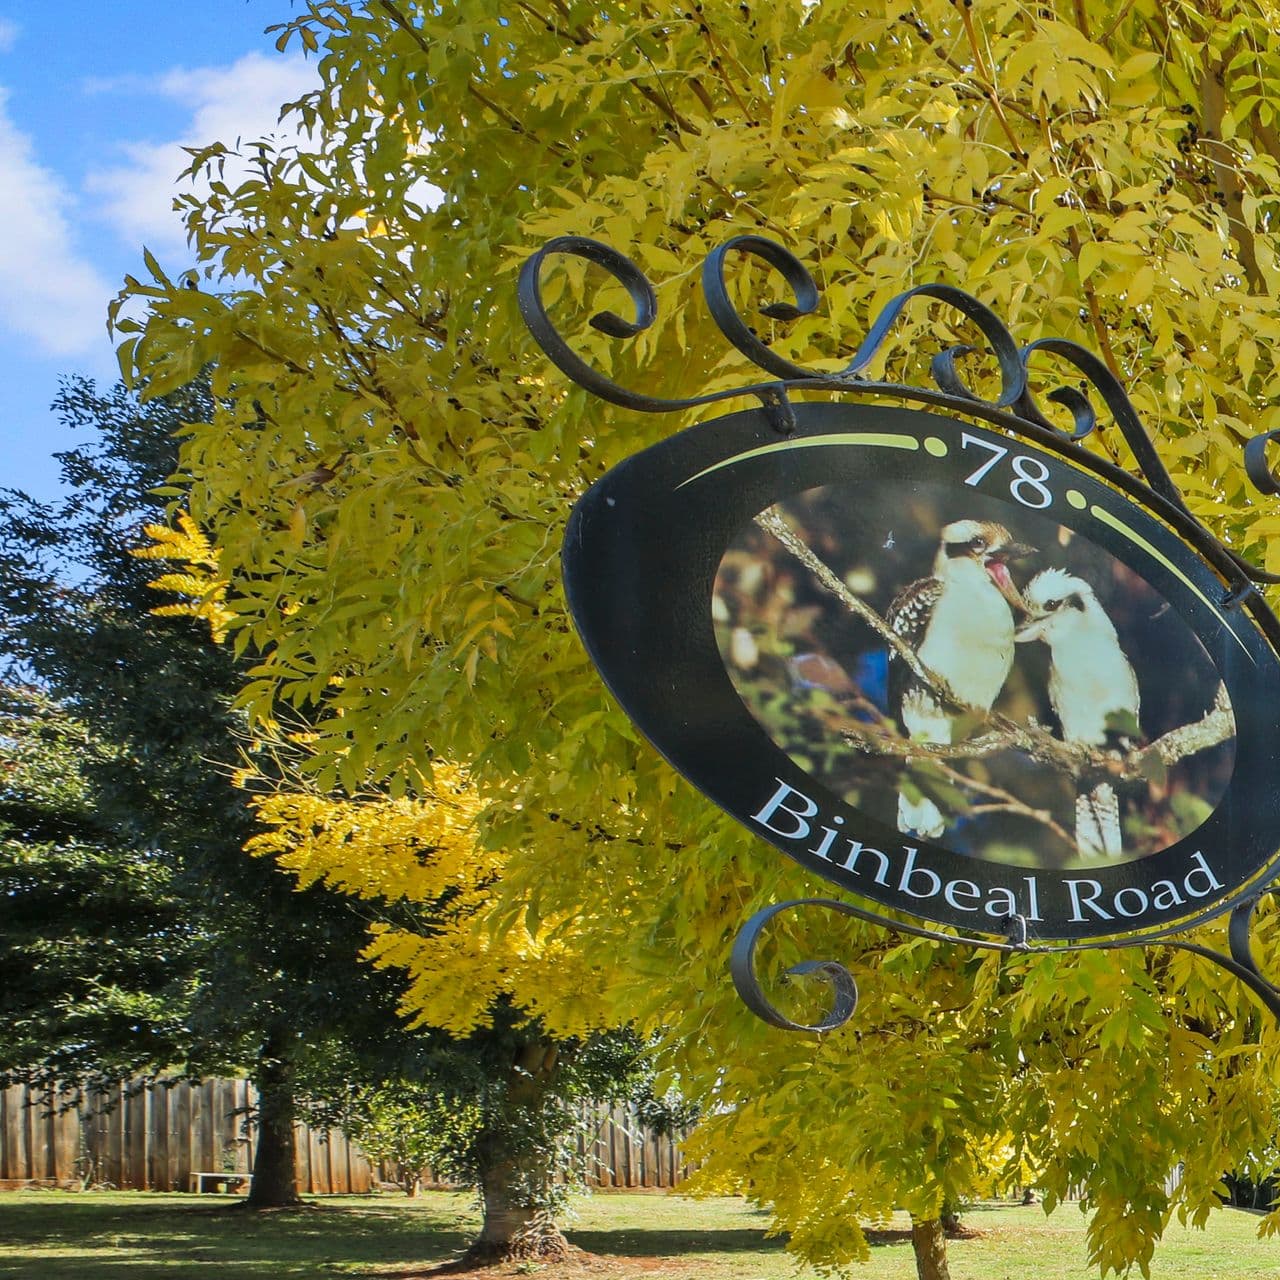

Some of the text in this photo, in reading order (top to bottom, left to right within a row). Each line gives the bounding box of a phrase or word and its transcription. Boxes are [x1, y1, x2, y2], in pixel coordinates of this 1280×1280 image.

[961, 432, 1052, 509] 78
[749, 776, 1226, 923] Binbeal Road
